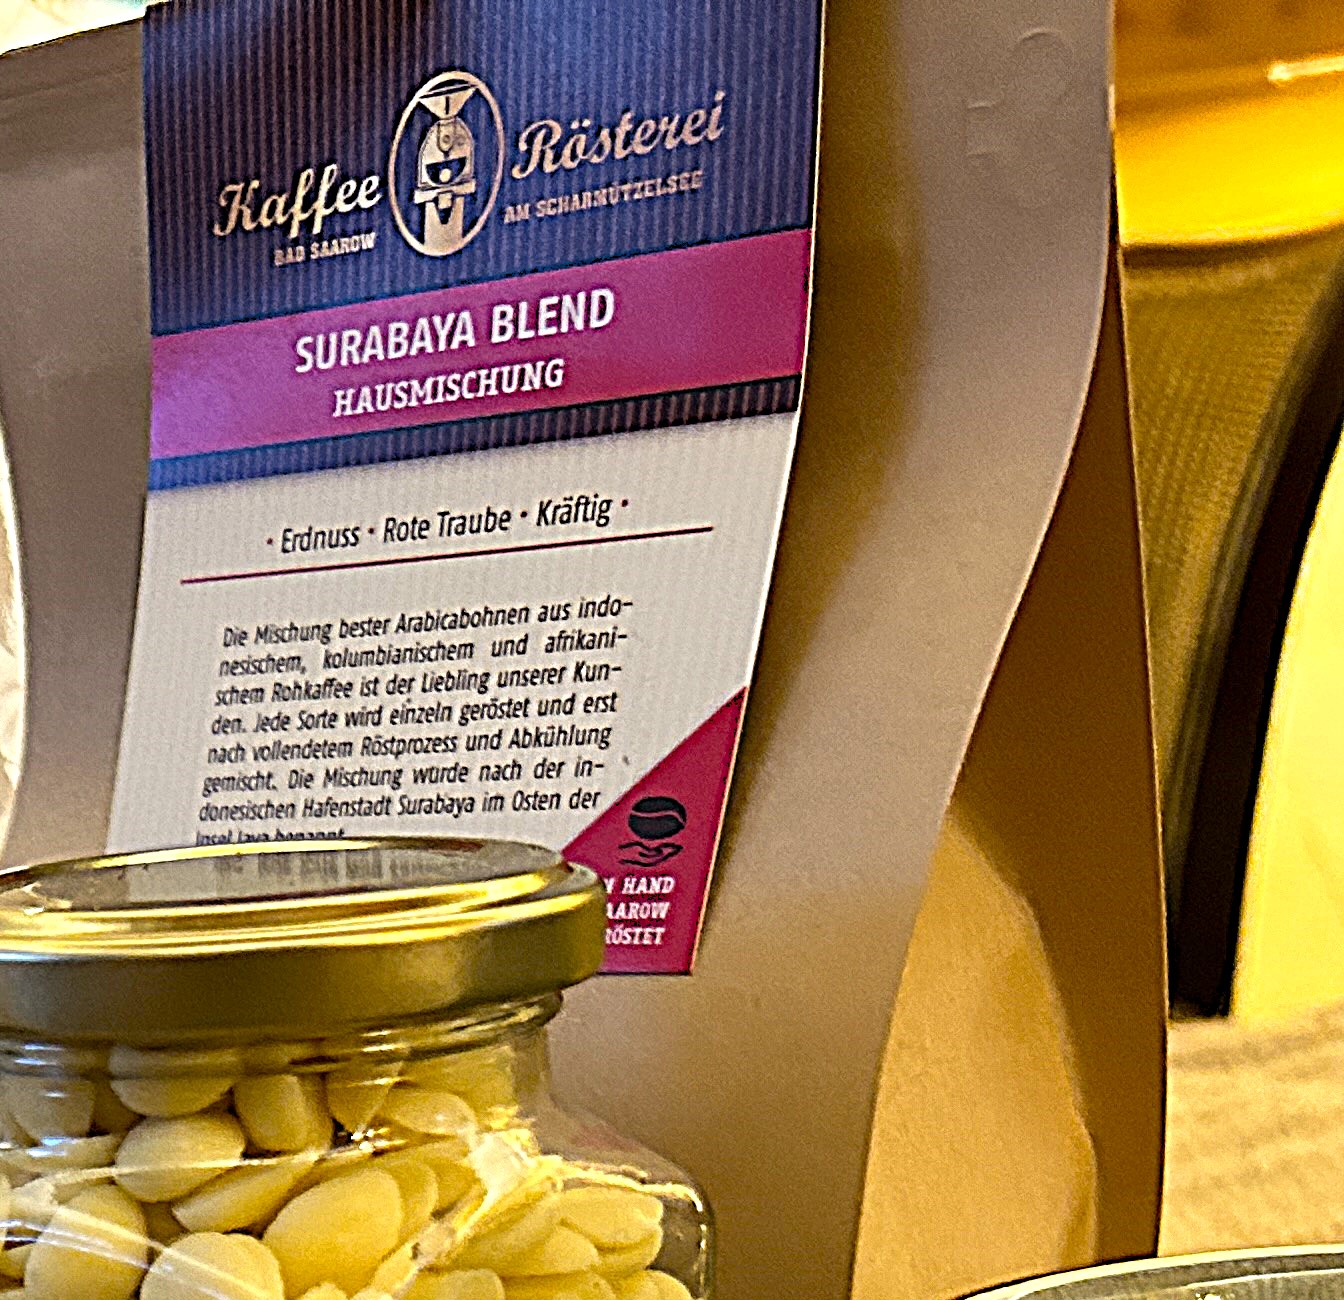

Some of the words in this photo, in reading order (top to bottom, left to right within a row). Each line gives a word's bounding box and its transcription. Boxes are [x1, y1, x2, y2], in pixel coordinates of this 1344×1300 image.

[213, 164, 384, 238] Kaffee
[512, 90, 727, 181] Rösterei
[503, 202, 531, 224] AM
[535, 168, 705, 219] SCHARMÜTZELSEE
[273, 247, 306, 267] BAD
[310, 231, 376, 262] SAAROW
[293, 309, 478, 376] SURABAYA
[490, 287, 617, 346] BLEND
[331, 358, 567, 419] HAUSMISCHUNG
[280, 525, 361, 555] Erdnuss
[383, 517, 431, 544] Rote
[437, 507, 513, 539] Traube
[535, 493, 613, 528] Kräftig
[222, 625, 249, 649] Die
[253, 619, 334, 646] Mischung
[338, 617, 392, 640] bester
[394, 606, 531, 635] Arabicabohnen
[537, 602, 572, 623] aus
[577, 594, 635, 620] indo-
[218, 652, 308, 677] nesischem,
[321, 640, 475, 671] kolumbianischem
[490, 633, 530, 659] und
[543, 626, 629, 655] afrikani-
[214, 685, 266, 708] schem
[270, 677, 355, 703] Rohkaffee
[359, 675, 381, 698] ist
[385, 673, 416, 697] der
[420, 668, 492, 696] Liebling
[495, 664, 568, 690] unserer
[572, 658, 624, 685] Kun-
[211, 713, 248, 736] den.
[252, 711, 292, 734] Jede
[295, 708, 340, 731] Sorte
[343, 702, 385, 729] wird
[388, 697, 454, 727] einzeln
[457, 696, 532, 728] geröstet
[536, 691, 577, 718] und
[581, 691, 619, 715] erst
[206, 741, 247, 765] nach
[251, 737, 355, 763] vollendetem
[359, 733, 459, 760] Röstprozess
[464, 726, 505, 753] und
[507, 722, 614, 751] Abkühlung
[200, 768, 279, 798] gemischt.
[286, 767, 315, 790] Die
[321, 764, 405, 792] Mischung
[412, 762, 470, 786] wurde
[477, 758, 524, 784] nach
[532, 756, 567, 781] der
[573, 755, 606, 779] in-
[197, 799, 297, 823] donesischen
[301, 794, 394, 819] Hafenstadt
[396, 793, 477, 820] Surabaya
[481, 790, 506, 813] im
[511, 788, 562, 812] Osten
[567, 786, 602, 811] der
[621, 875, 676, 896] HAND
